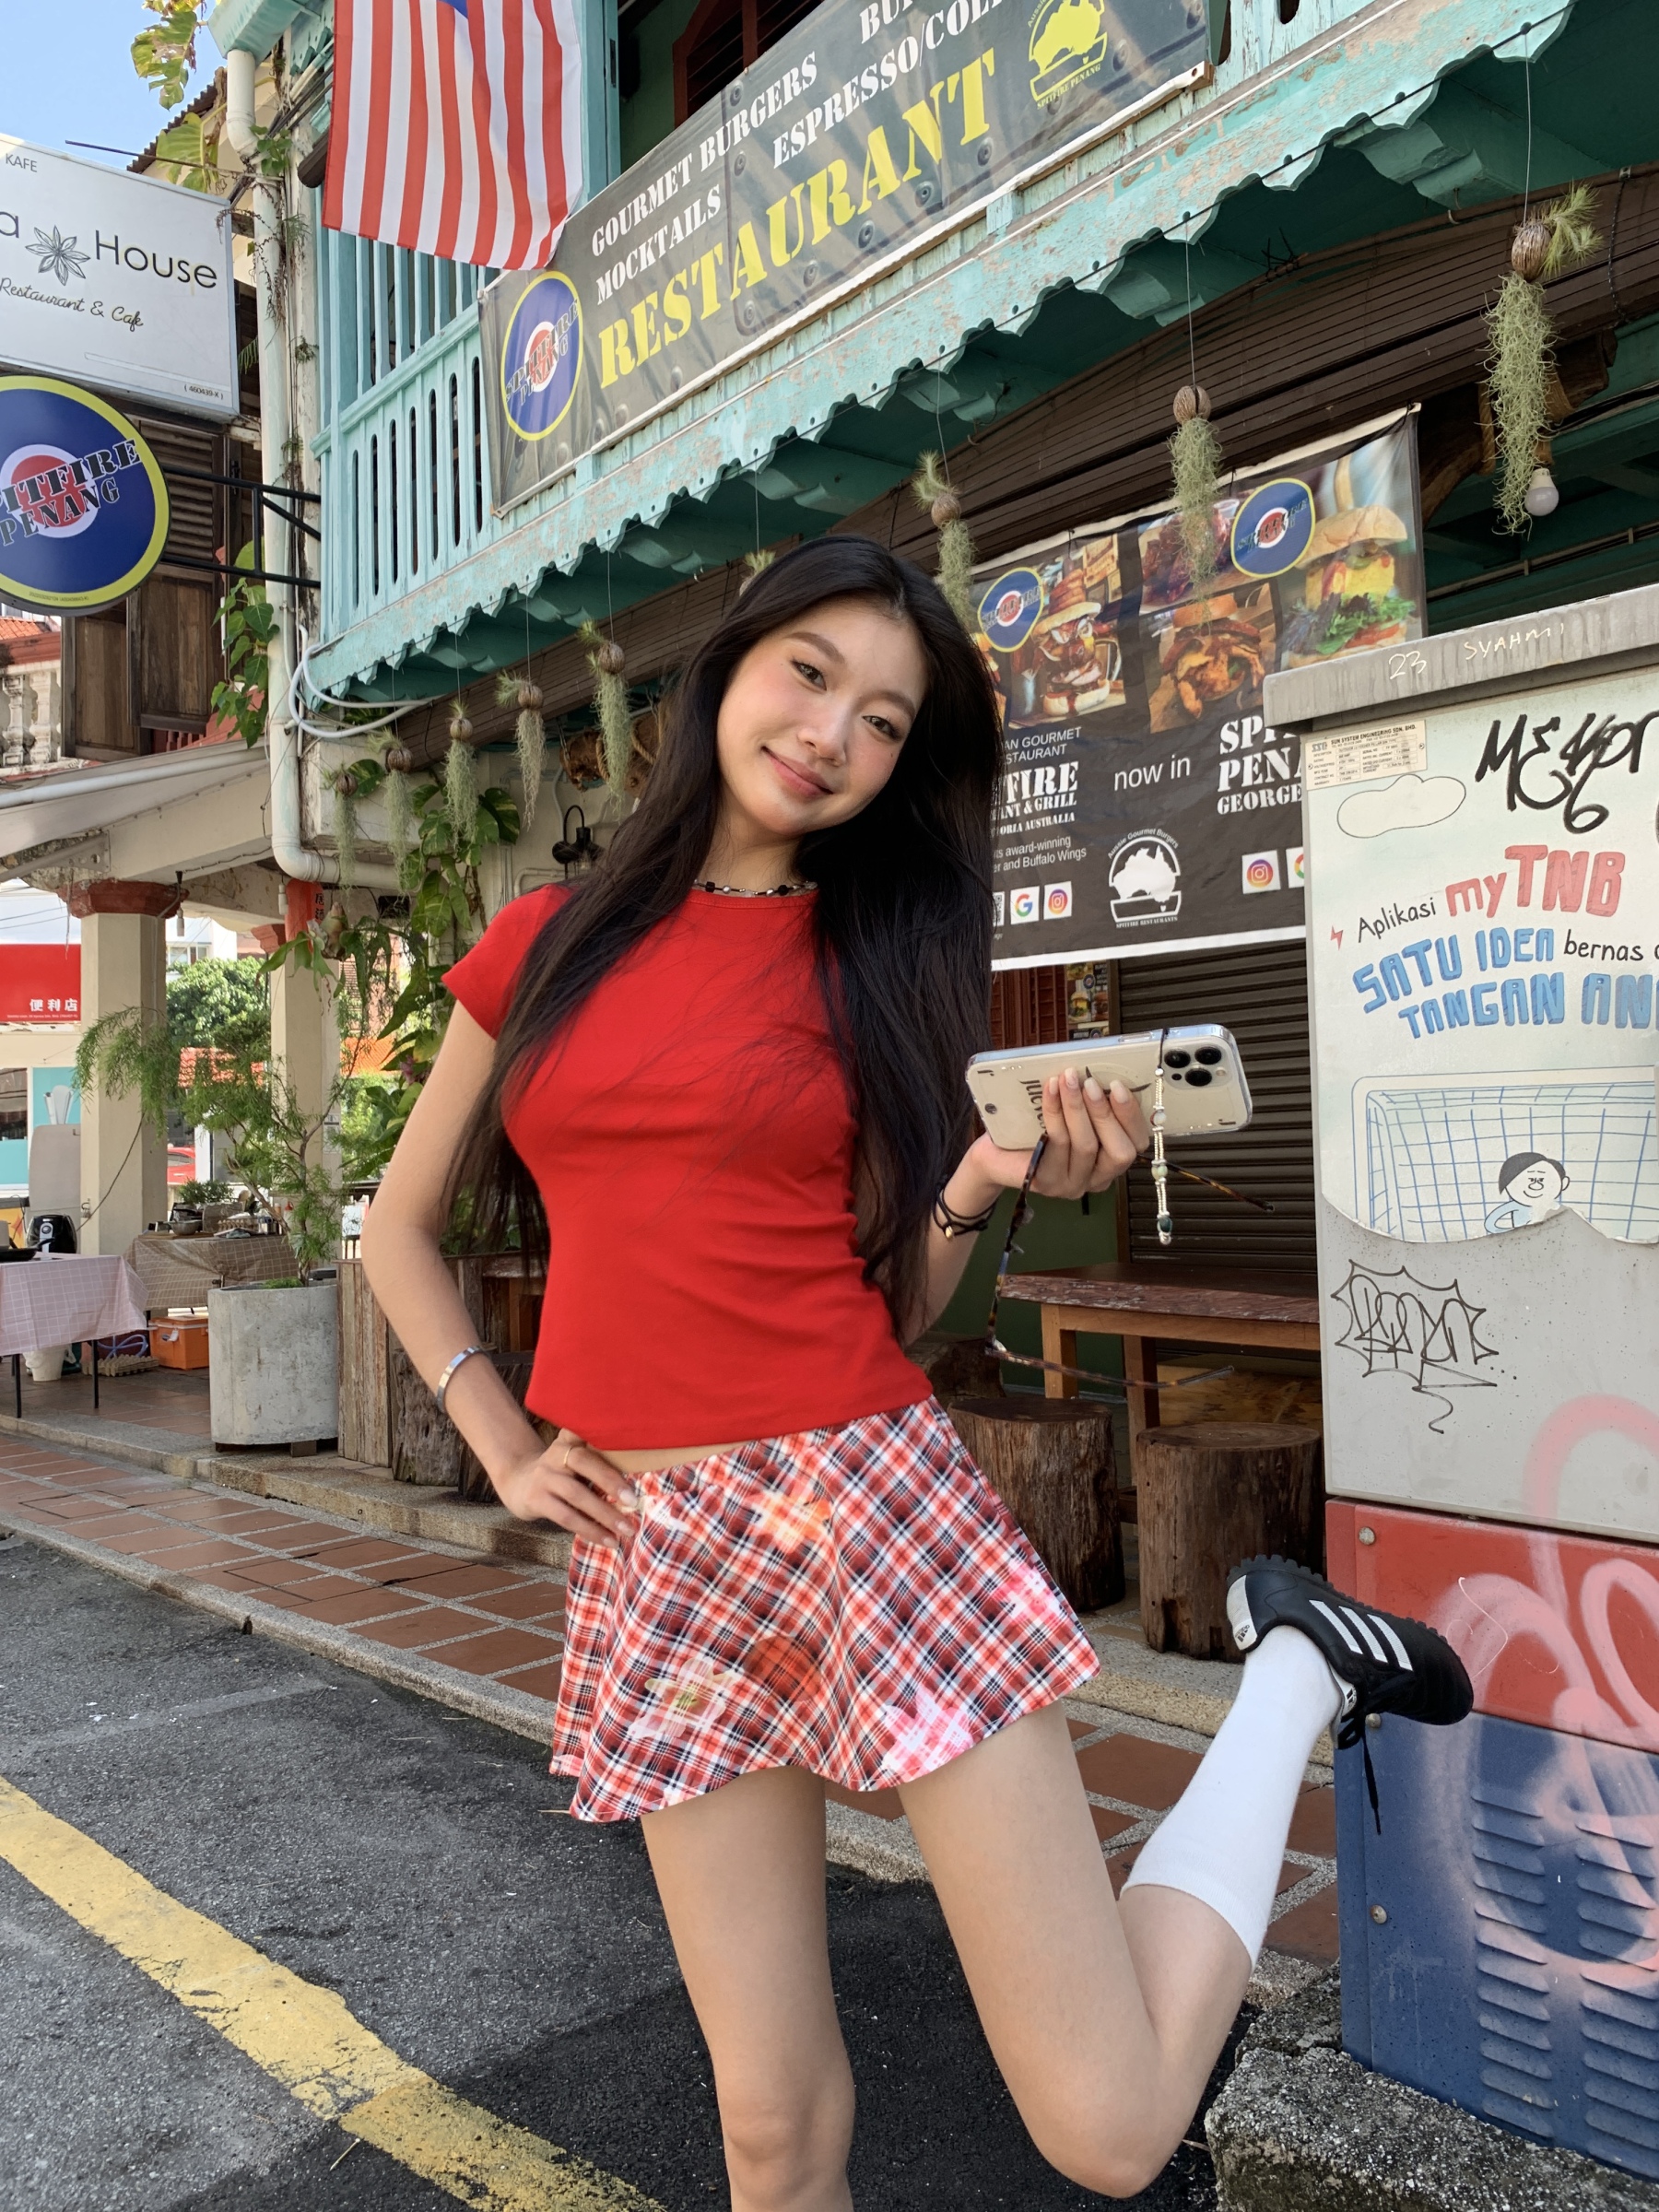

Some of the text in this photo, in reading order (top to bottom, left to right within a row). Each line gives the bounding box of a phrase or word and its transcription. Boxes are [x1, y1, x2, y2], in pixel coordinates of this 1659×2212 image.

[859, 0, 913, 44] BU
[1028, 0, 1047, 28] Aussi
[773, 0, 1003, 169] ESPRESSO/COL
[1070, 64, 1101, 88] PENANG
[5, 153, 38, 172] KAFE
[591, 51, 818, 257] GOURMET BURGERS
[597, 47, 994, 389] RESTAURANT
[95, 229, 218, 288] House
[595, 184, 722, 305] MOCKTAILS
[0, 277, 145, 332] Restaurant & Cafe
[505, 297, 579, 403] SPITFIRE
[521, 335, 569, 406] PENANG
[0, 437, 141, 514] ITFIRE
[0, 477, 120, 546] PENANG
[1388, 651, 1427, 679] 23
[1005, 726, 1082, 750] AN GOURMET
[1006, 744, 1067, 765] STAURANT
[1341, 735, 1359, 743] SYSTEM
[1360, 728, 1392, 739] ENGINEERING
[1002, 761, 1078, 804] FIRE
[1114, 754, 1191, 792] now in
[994, 793, 1077, 820] ANT & GRILL
[1217, 782, 1301, 815] GEORGE
[994, 812, 1075, 836] ORIA AUSTRALIA
[1108, 829, 1179, 859] Aussie Gourmet Burgers
[1003, 858, 1020, 871] and
[1022, 853, 1056, 868] Buffalo
[1057, 847, 1087, 862] Wings
[1005, 836, 1071, 856] award-winning
[1357, 844, 1626, 943] Aplikasi myTNB
[1352, 926, 1644, 1014] SATU IDEA bernas
[29, 997, 78, 1012] 便利店
[1398, 971, 1659, 1039] TANGAN AN
